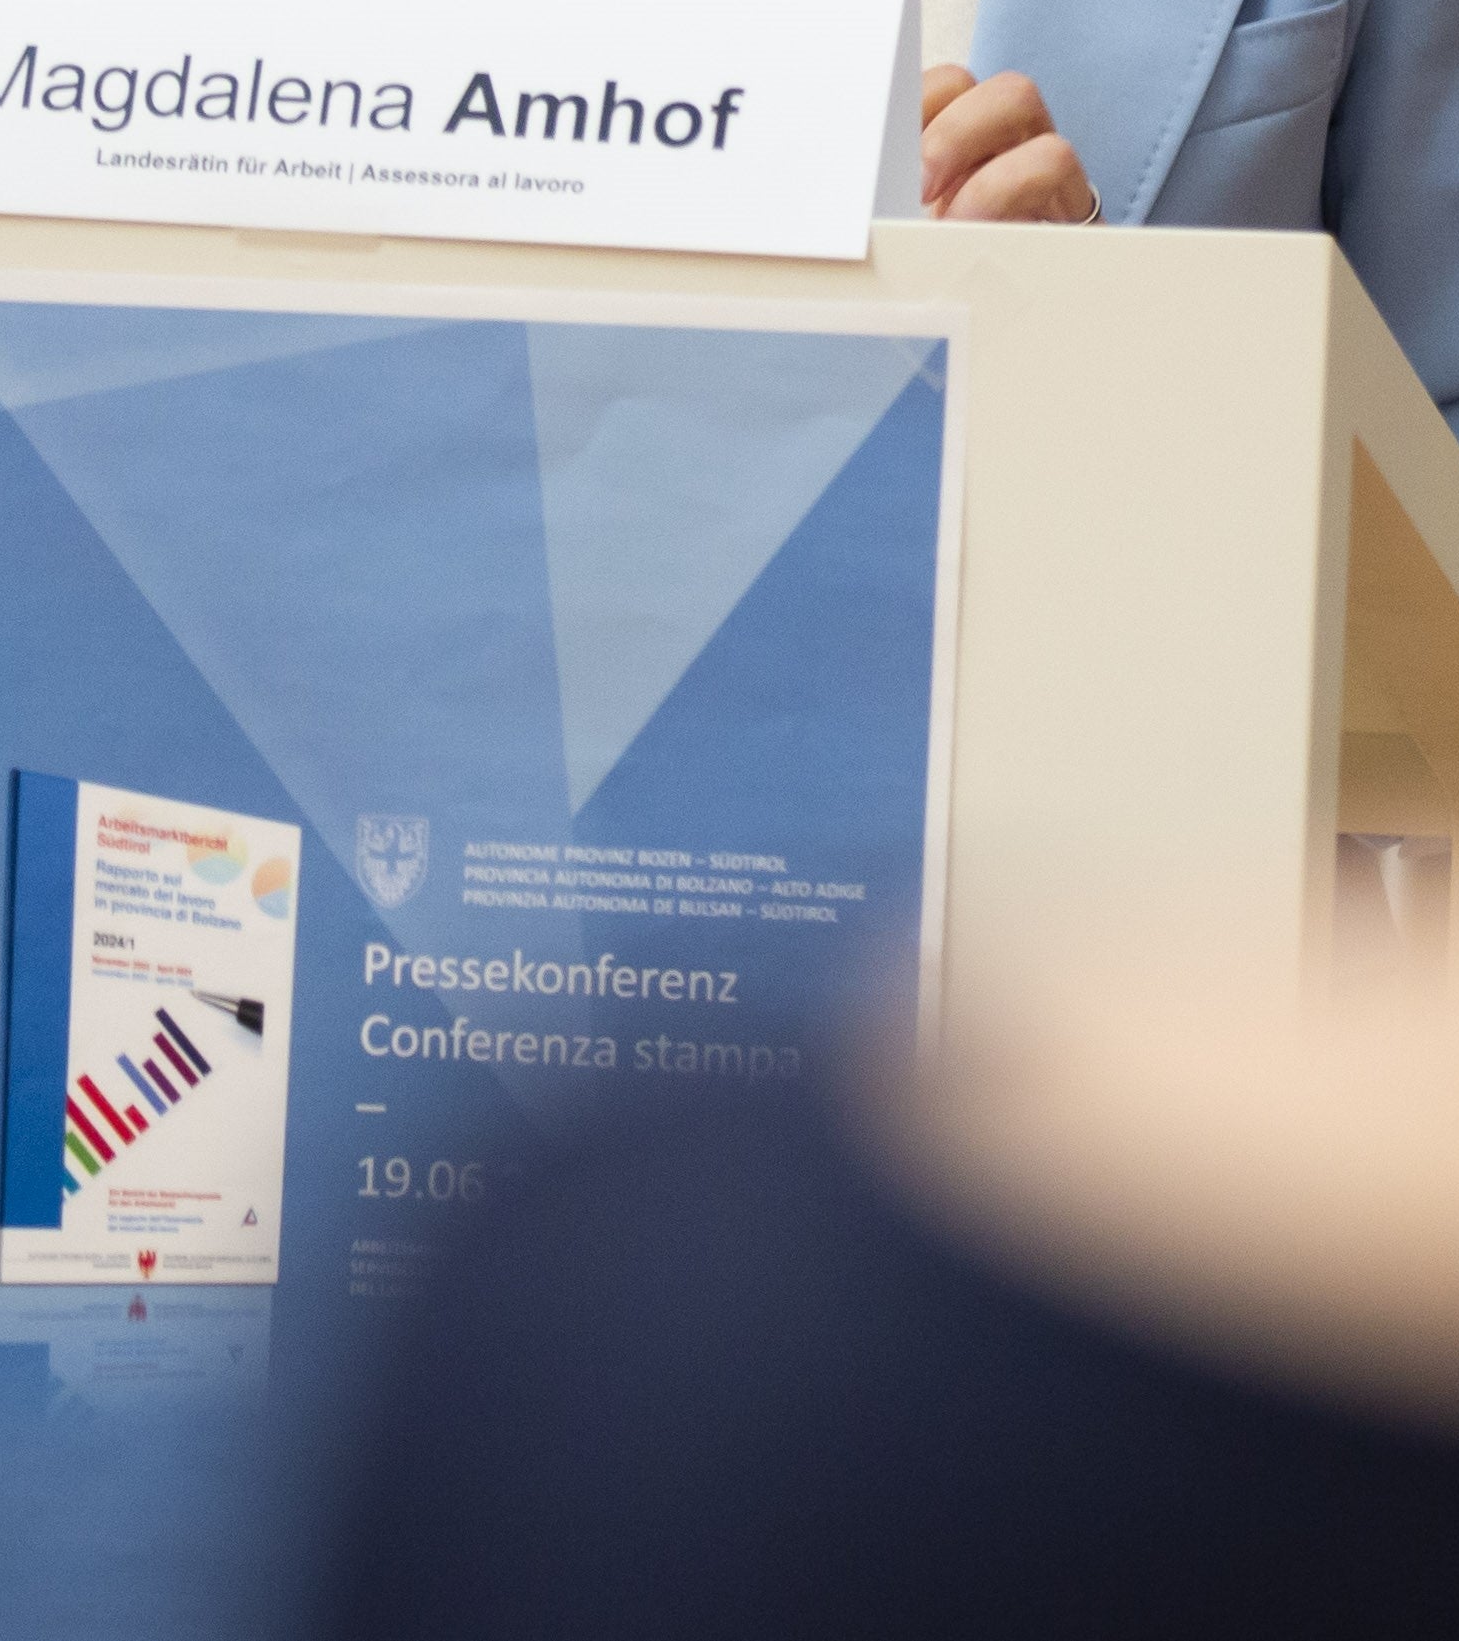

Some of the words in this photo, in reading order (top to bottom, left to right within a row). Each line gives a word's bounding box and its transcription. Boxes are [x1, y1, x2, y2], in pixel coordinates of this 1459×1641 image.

[443, 71, 745, 150] Amhof
[96, 148, 229, 174] Landesrätin
[237, 156, 267, 176] für
[274, 158, 343, 180] Arbeit
[362, 164, 480, 188] Assessora
[489, 171, 507, 190] al
[515, 173, 584, 194] lavoro
[97, 831, 150, 854] Südtirol
[98, 815, 228, 851] Arbeitsmarktbericht
[96, 858, 159, 882] Rapporto
[464, 843, 558, 861] AUTONOME
[565, 846, 634, 864] PROVINZ
[639, 850, 691, 867] BOZEN
[95, 880, 150, 899] mercato
[154, 887, 173, 902] del
[464, 866, 549, 884] PROVINCIA
[555, 870, 651, 889] AUTONOMA
[656, 874, 672, 891] DI
[676, 876, 753, 894] BOLZANO
[771, 881, 812, 897] ALTO
[815, 883, 866, 900] ADIGE
[94, 896, 107, 909] in
[111, 900, 172, 919] provincia
[176, 908, 187, 922] di
[192, 911, 242, 930] Bolzano
[553, 894, 649, 913] AUTONOMA
[653, 899, 673, 915] DE
[363, 942, 739, 1004] Pressekonferenz
[359, 1013, 618, 1068] Conferenza
[634, 1033, 800, 1086] stampa
